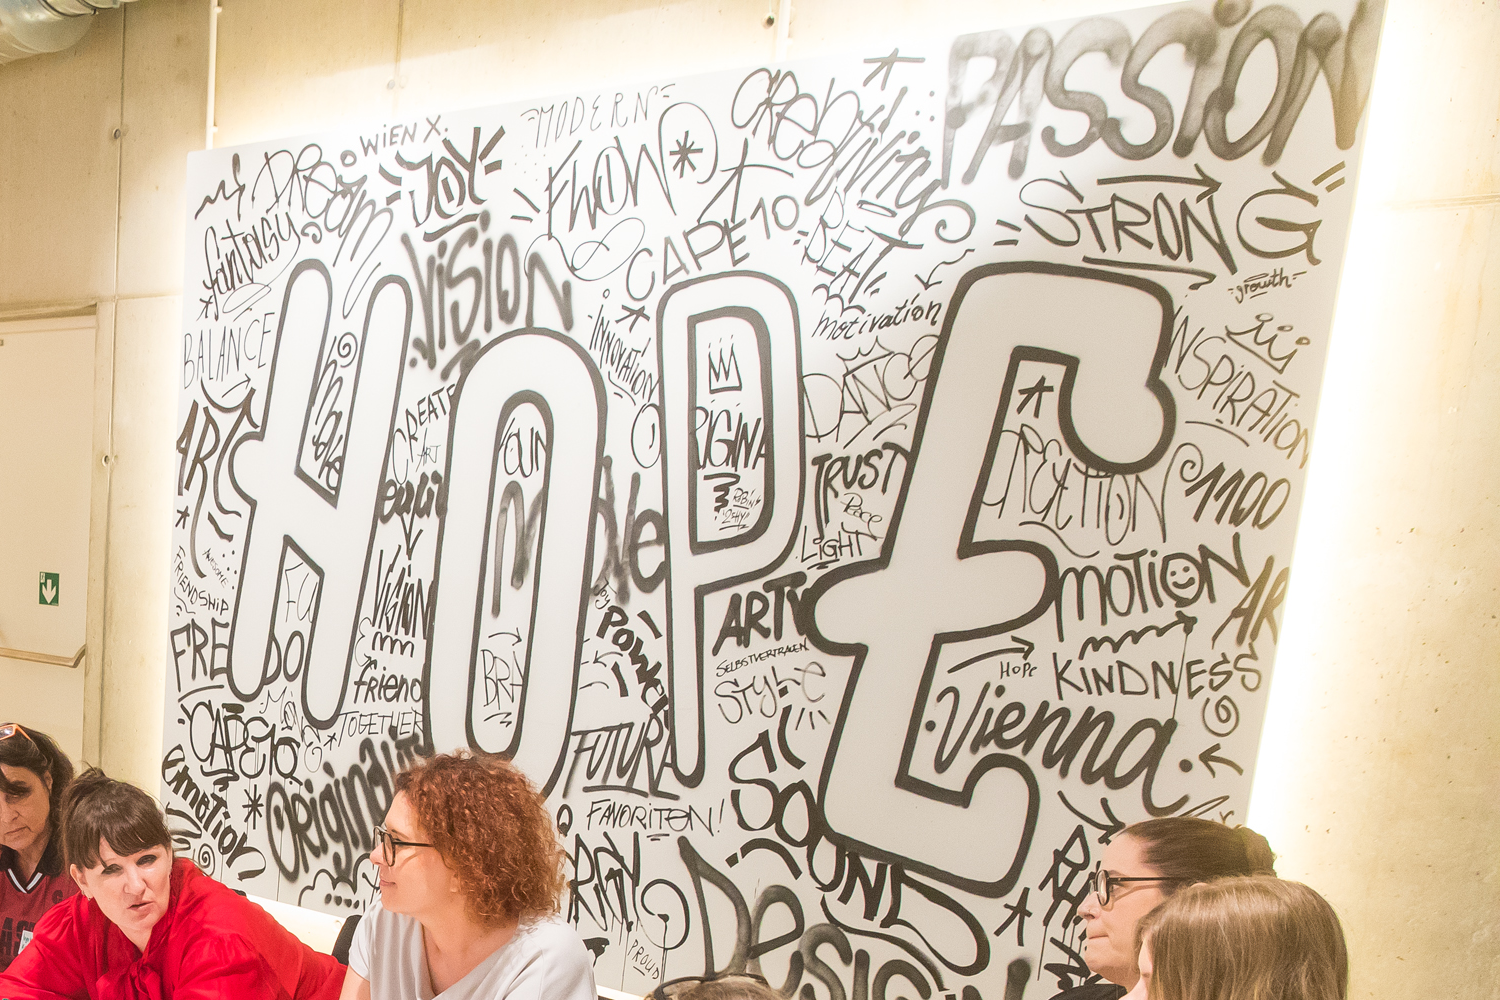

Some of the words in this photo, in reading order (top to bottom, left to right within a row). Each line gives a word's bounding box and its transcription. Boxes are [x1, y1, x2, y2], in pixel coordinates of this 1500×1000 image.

[626, 217, 751, 301] CAPE
[1019, 169, 1323, 275] STRONG
[811, 293, 943, 341] motivation
[1236, 267, 1293, 304] growth
[184, 312, 276, 390] BALANCE
[228, 256, 1179, 899] HOPE
[934, 681, 1191, 818] Vienna
[626, 938, 661, 981] PROUD
